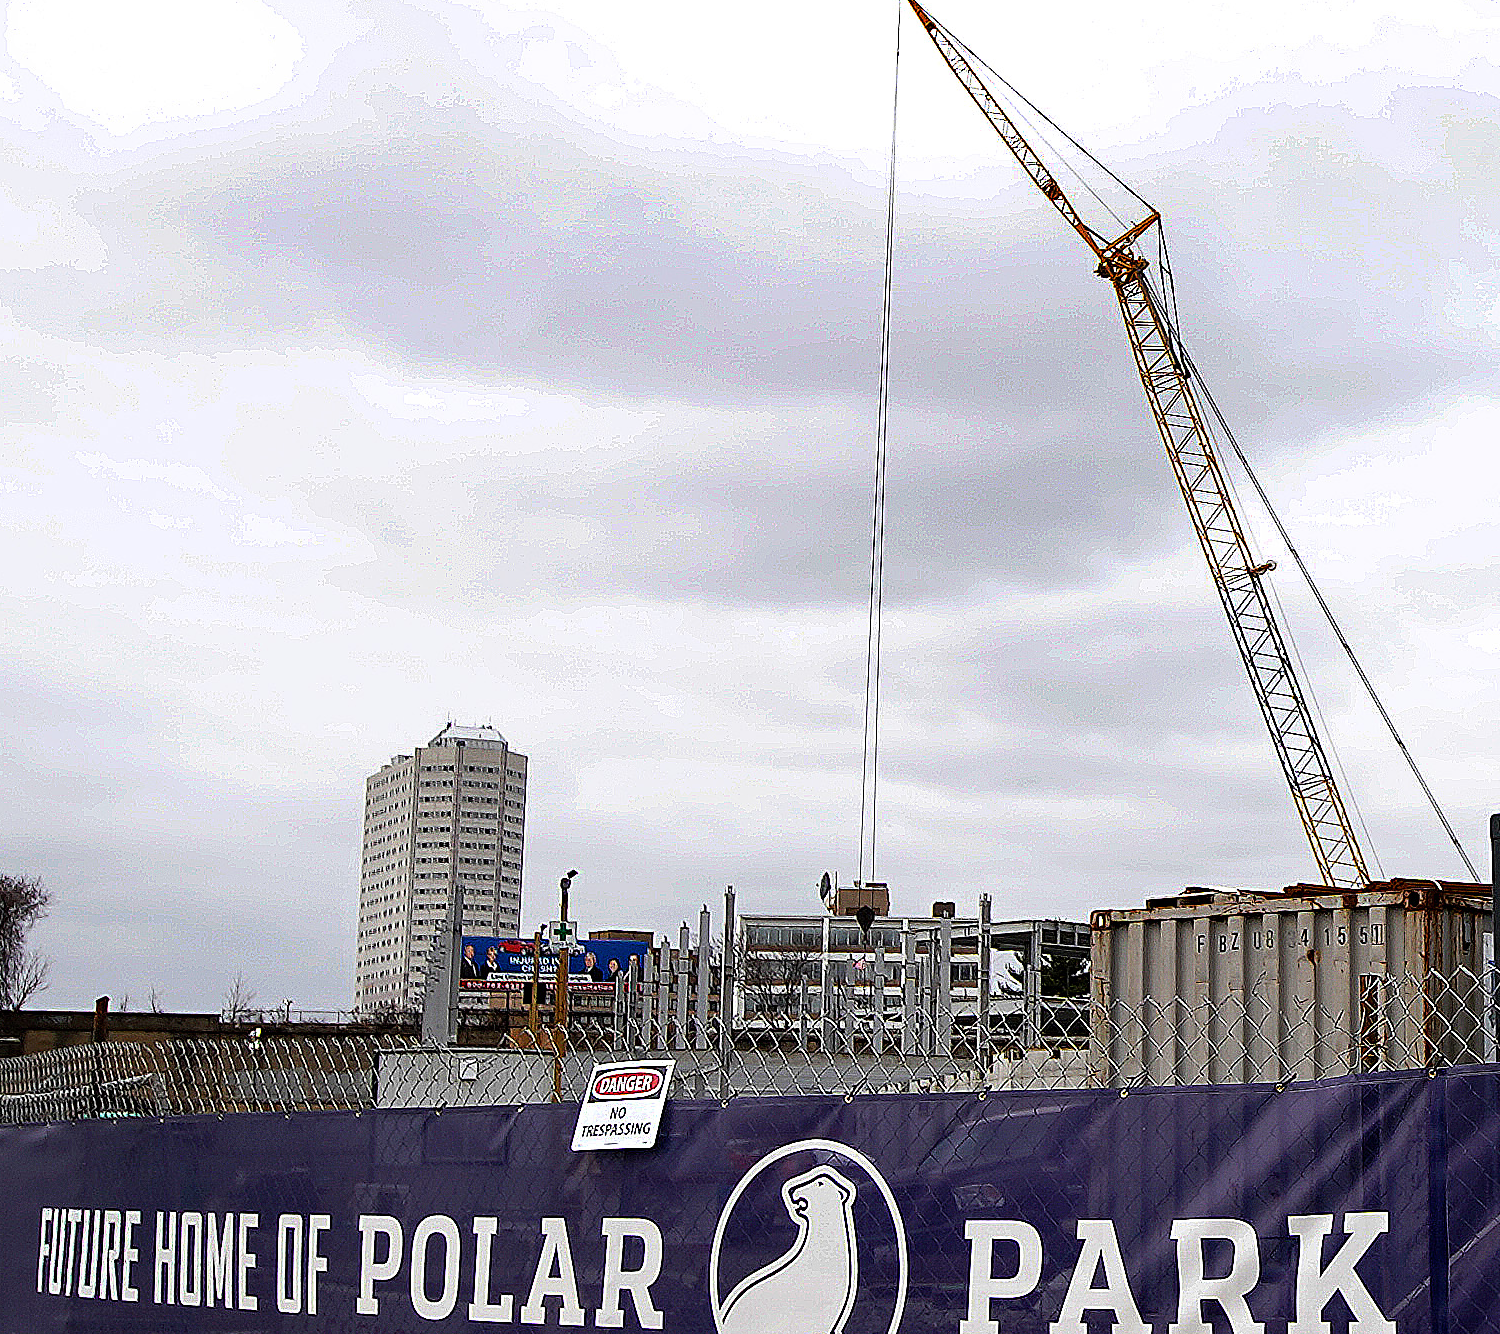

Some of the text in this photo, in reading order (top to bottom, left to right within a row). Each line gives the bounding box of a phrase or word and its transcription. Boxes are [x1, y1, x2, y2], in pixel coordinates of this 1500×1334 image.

[600, 1075, 653, 1093] DANGER
[610, 1107, 626, 1119] NO
[582, 1122, 651, 1137] TRESPASSING
[37, 1207, 141, 1302] FUTURE
[154, 1210, 258, 1311] HOME
[277, 1214, 331, 1315] OF
[356, 1214, 664, 1330] POLAR
